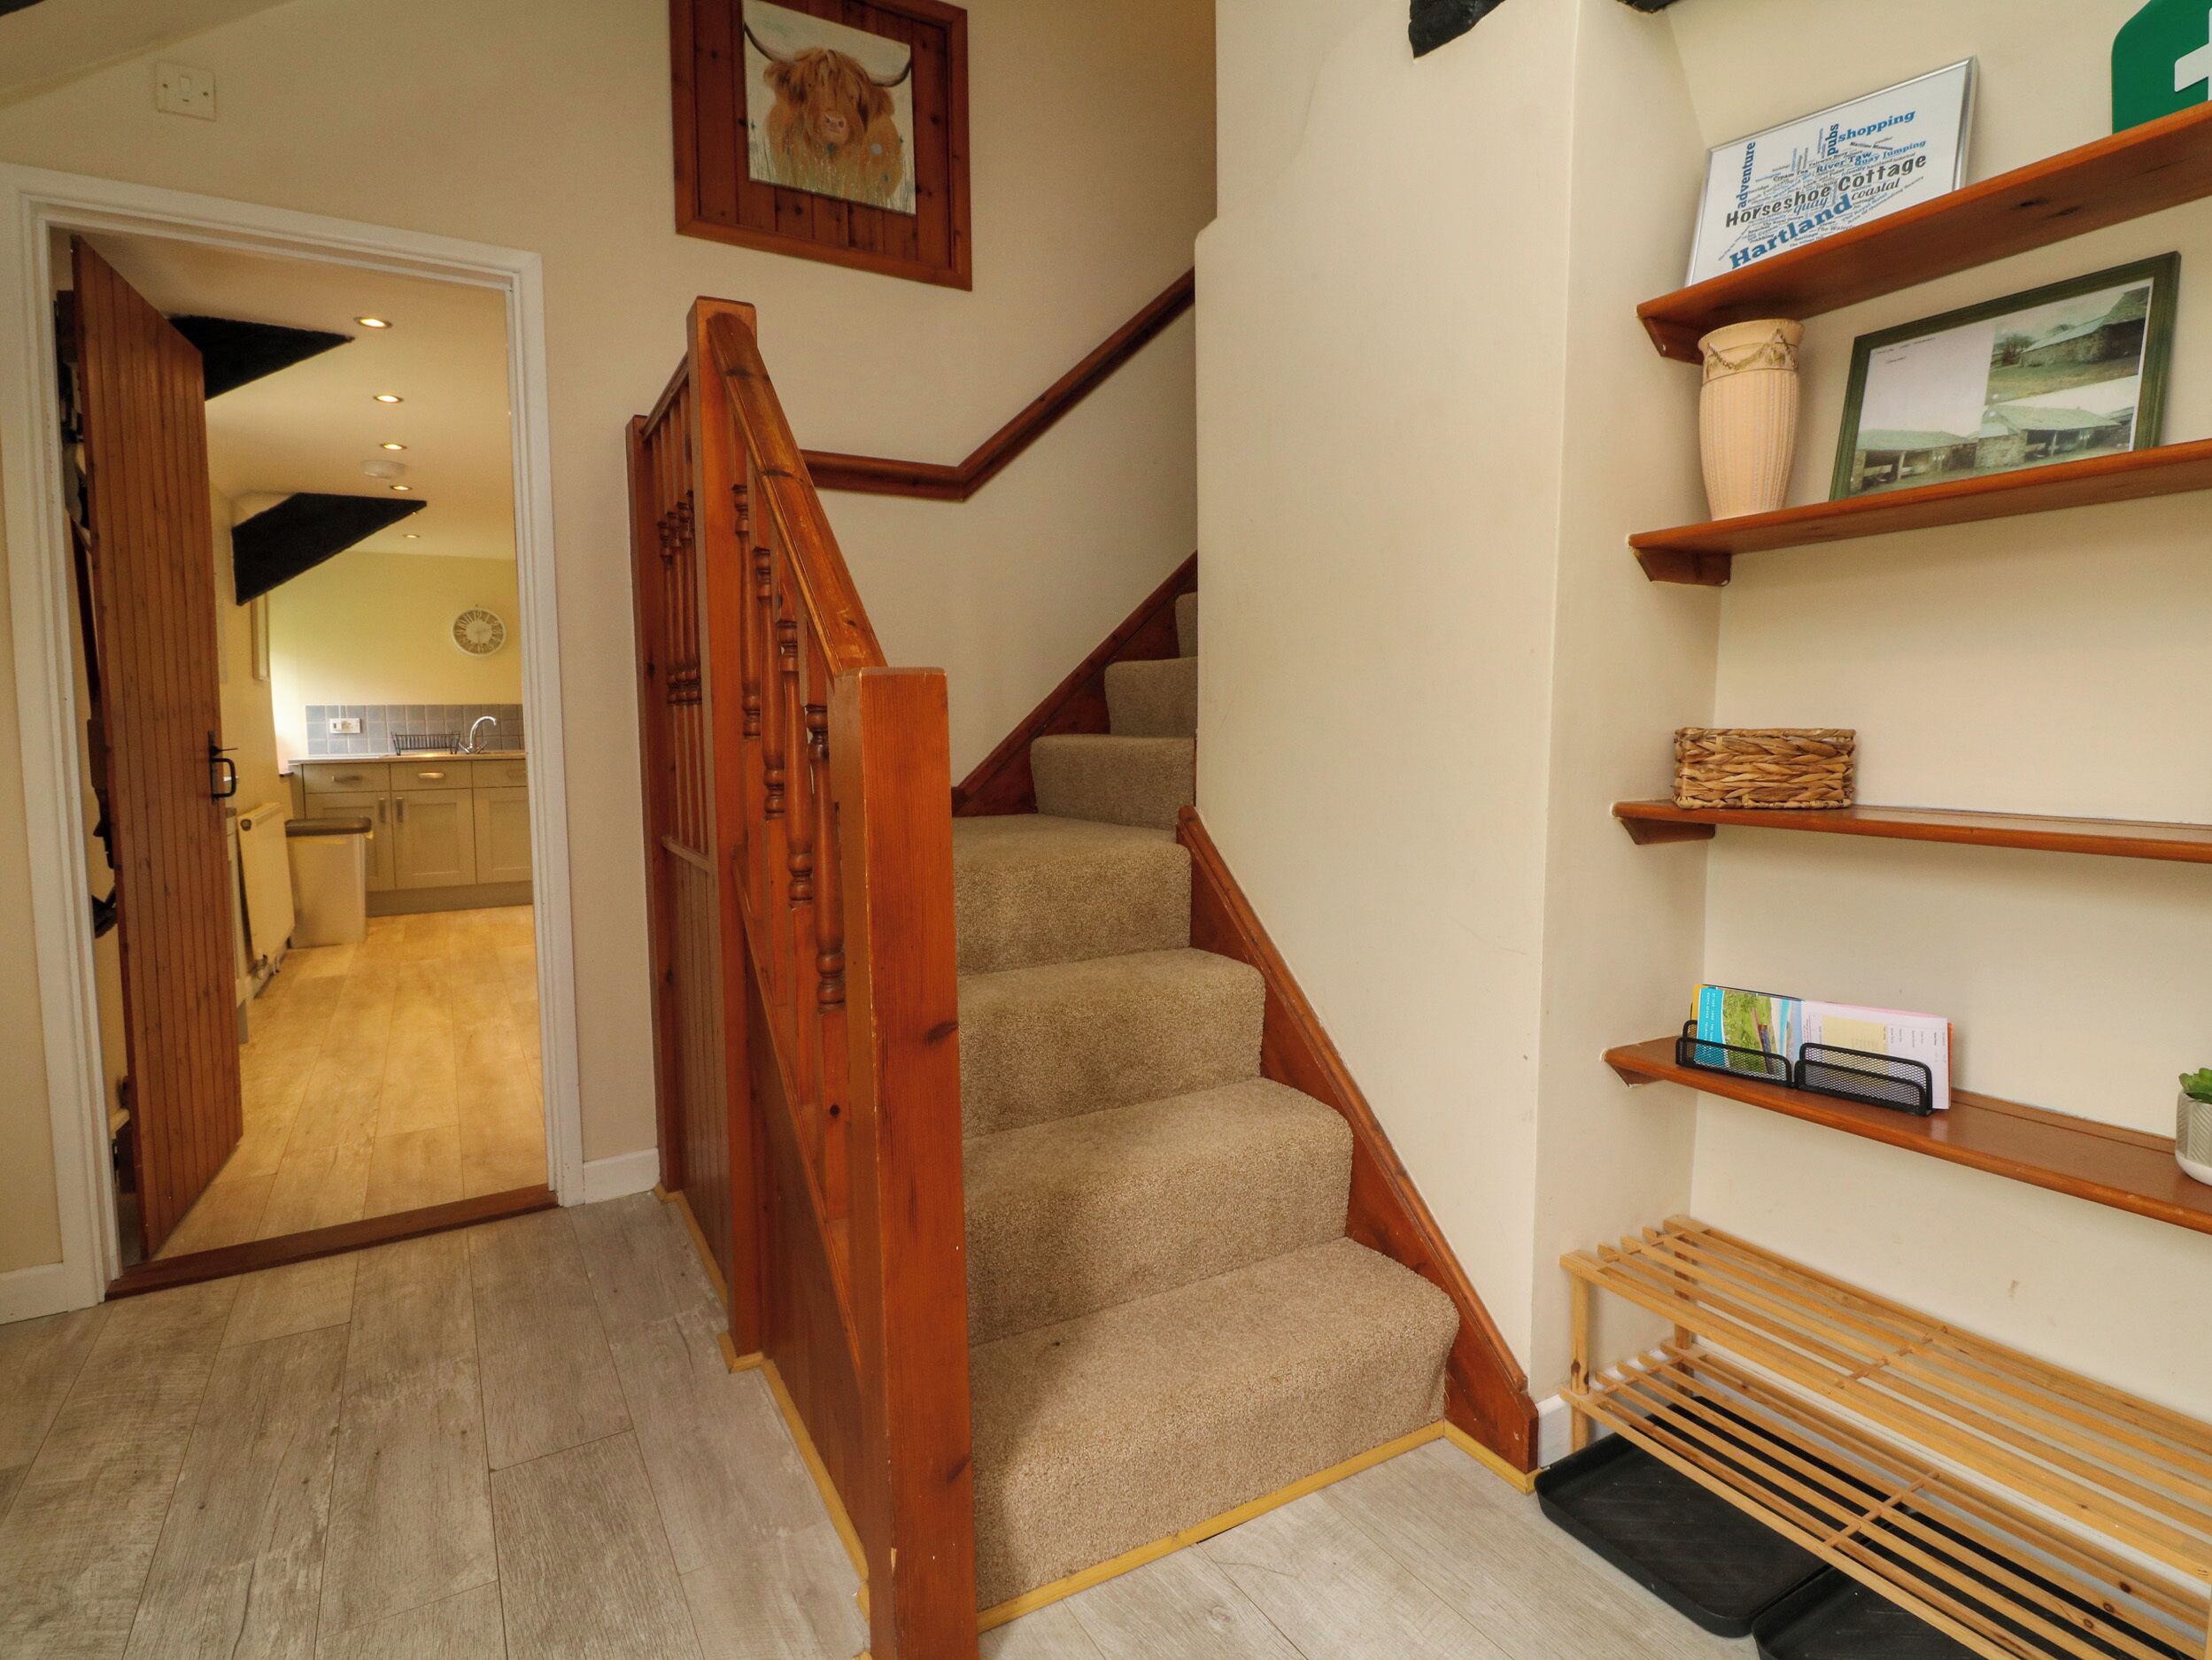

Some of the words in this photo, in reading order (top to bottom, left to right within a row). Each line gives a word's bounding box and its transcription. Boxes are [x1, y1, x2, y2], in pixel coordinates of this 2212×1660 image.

[1826, 124, 1839, 156] pubs
[1838, 111, 1915, 142] shopping
[1816, 159, 1845, 173] River
[1848, 151, 1872, 163] Taw
[1854, 155, 1881, 166] Quay
[1883, 140, 1926, 159] Jumping
[1737, 142, 1755, 208] adventure
[1852, 178, 1900, 200] coastal
[1726, 186, 1830, 228] Horseshoe
[1838, 156, 1926, 191] Cottage
[1794, 197, 1829, 215] quay
[1729, 193, 1852, 269] Hartland
